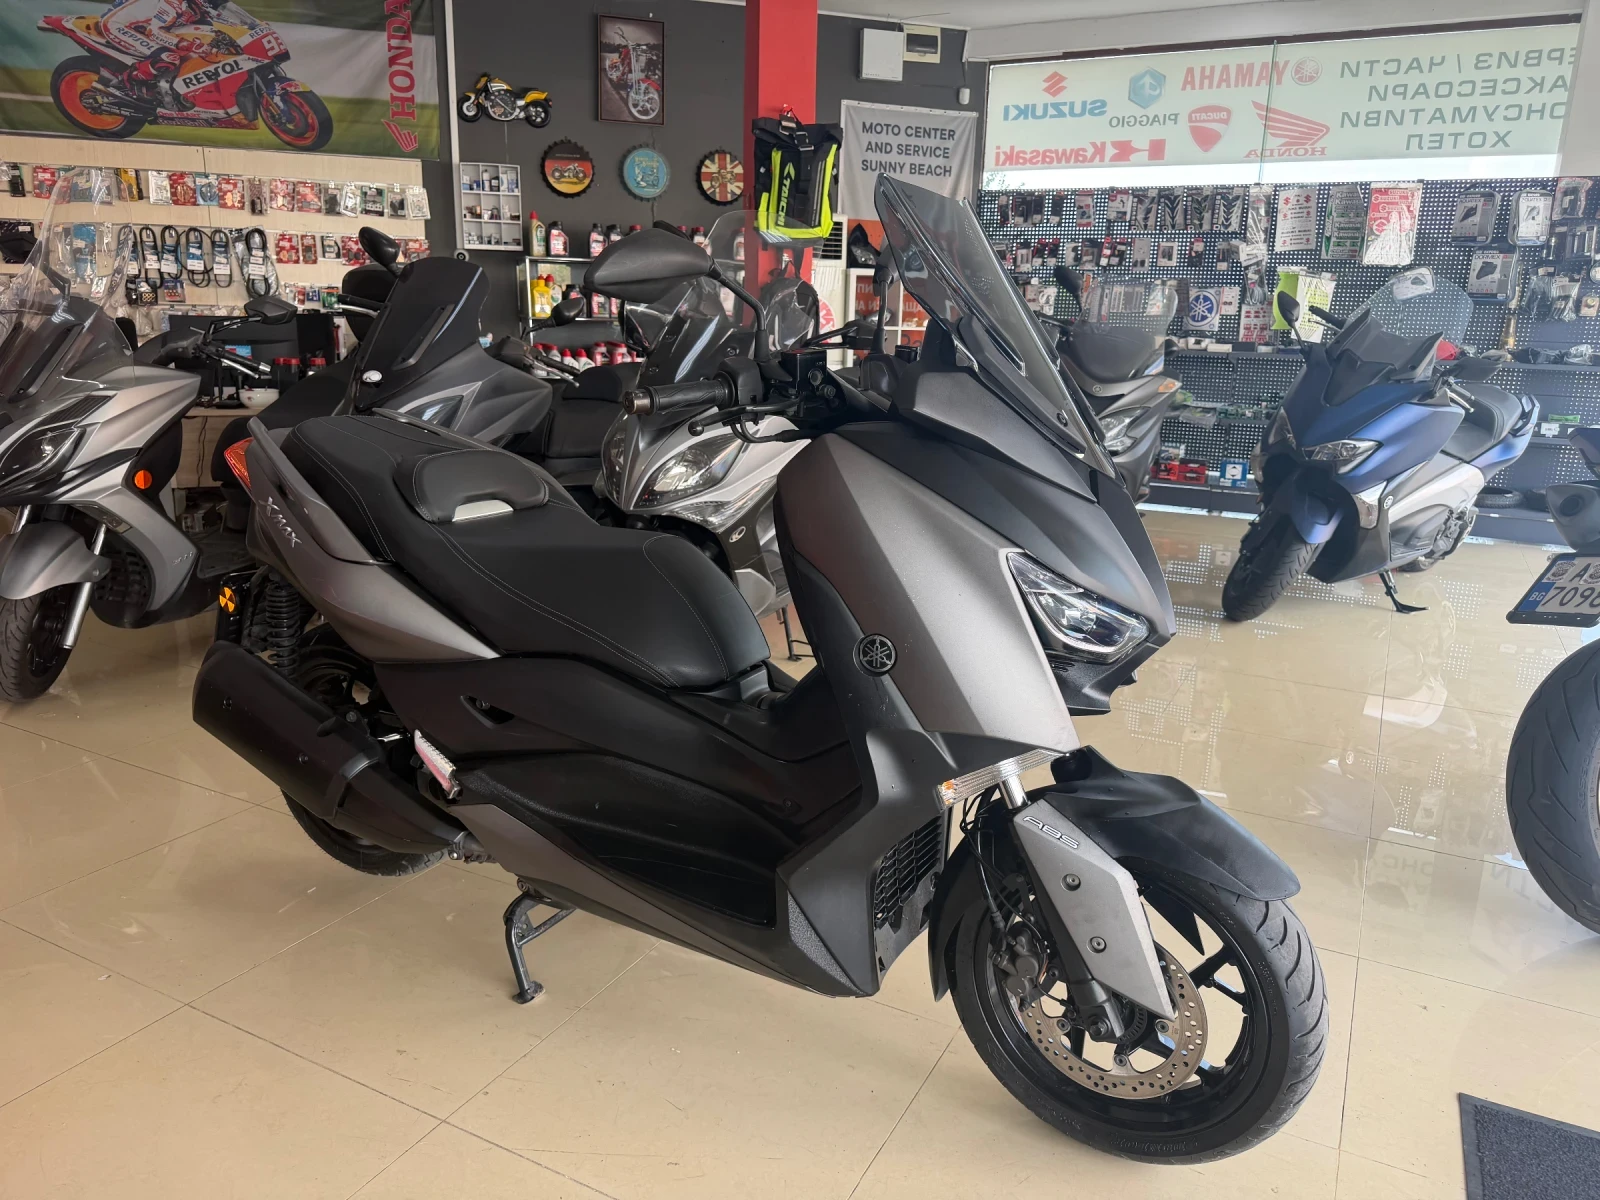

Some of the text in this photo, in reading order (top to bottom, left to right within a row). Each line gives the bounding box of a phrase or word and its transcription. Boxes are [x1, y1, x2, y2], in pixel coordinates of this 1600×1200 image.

[116, 26, 155, 51] REPSOL
[262, 33, 287, 57] 93
[384, 0, 417, 121] HONDA
[182, 59, 244, 90] REPSOL
[862, 121, 956, 141] MOTO CENTER
[865, 141, 950, 159] AND SERVICE
[861, 159, 952, 177] SUNNY BEACH
[1569, 563, 1592, 582] A
[1529, 592, 1546, 601] BG
[1023, 816, 1079, 849] ABS
